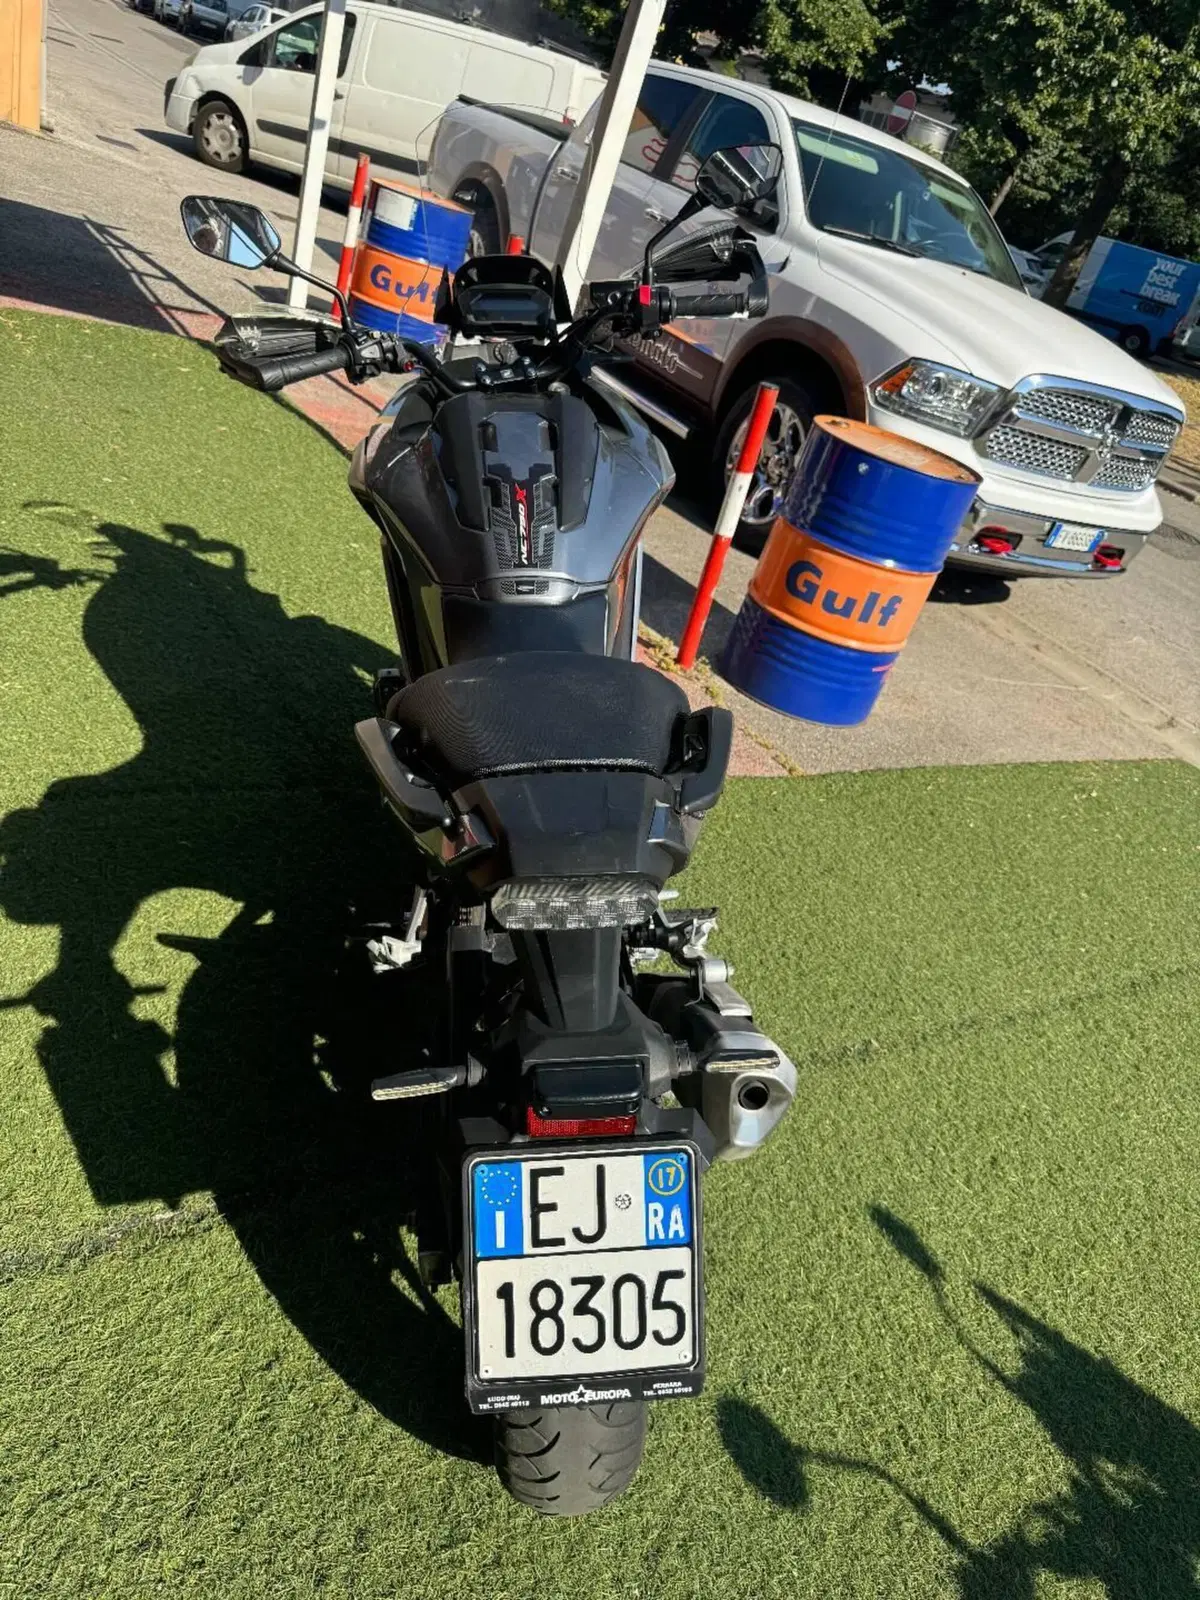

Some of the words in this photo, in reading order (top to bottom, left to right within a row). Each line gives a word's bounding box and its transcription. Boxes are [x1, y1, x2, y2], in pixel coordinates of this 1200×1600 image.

[785, 559, 903, 627] Gulf
[656, 1166, 677, 1189] 17
[494, 1210, 506, 1249] I
[529, 1163, 607, 1248] EJ
[648, 1202, 685, 1241] RA
[496, 1268, 687, 1359] 18305
